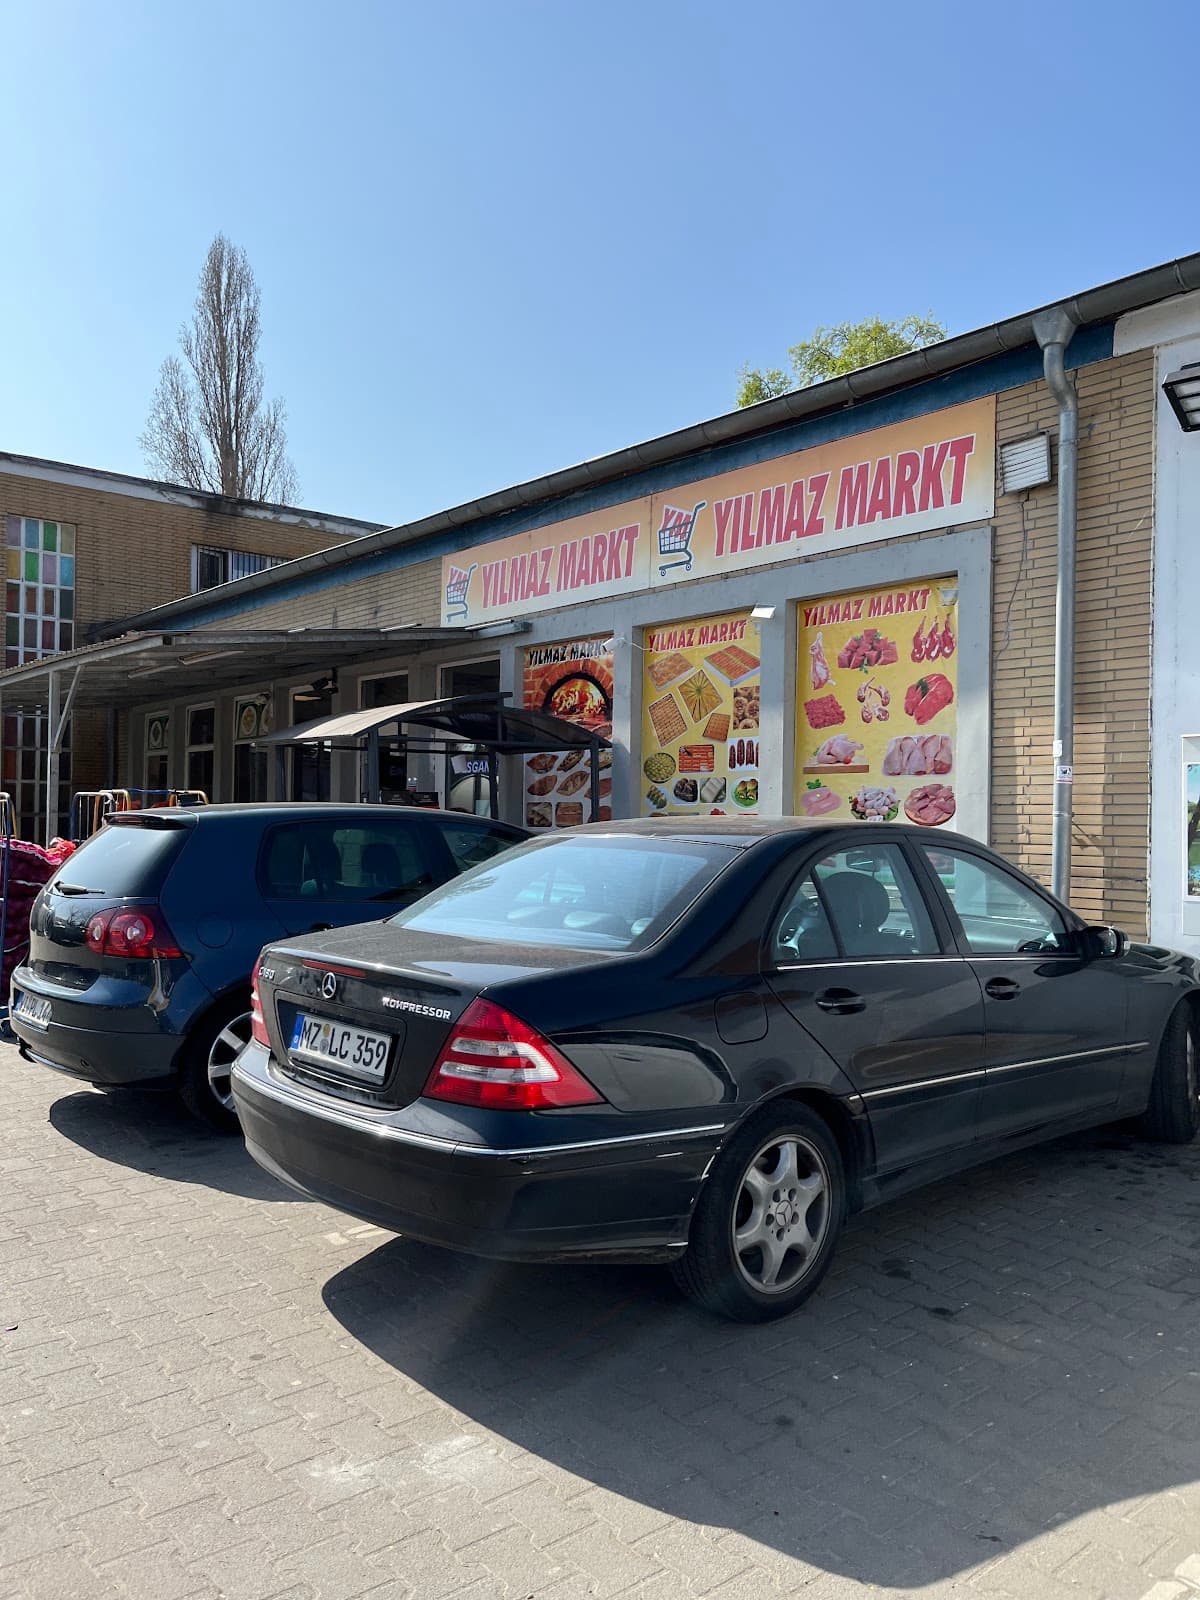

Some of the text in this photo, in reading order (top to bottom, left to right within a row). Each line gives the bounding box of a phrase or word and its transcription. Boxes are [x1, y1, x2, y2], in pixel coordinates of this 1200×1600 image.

[714, 434, 976, 558] YILMAZ MARKT
[482, 525, 639, 609] YILMAZ MARKT
[803, 589, 930, 628] YILMAZ MARKT
[529, 640, 605, 666] YILMAZ MARK
[648, 619, 747, 651] YILMAZ MARKT
[381, 997, 451, 1019] KOMPRESSOR
[300, 1020, 387, 1069] MZ LC 359
